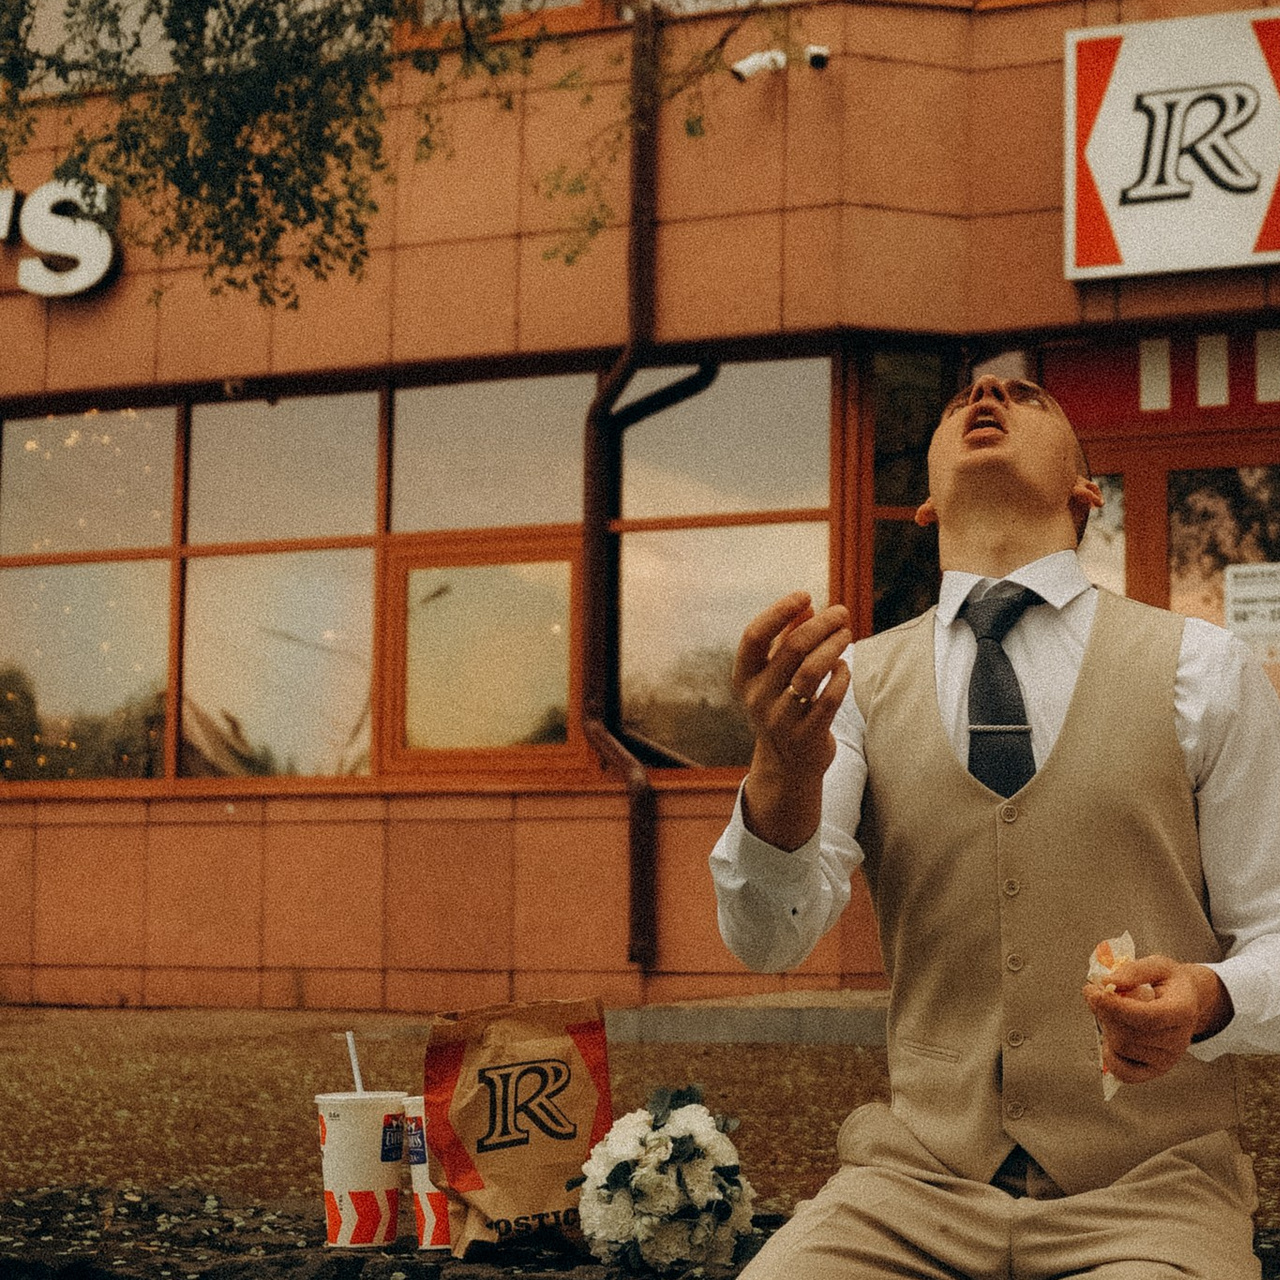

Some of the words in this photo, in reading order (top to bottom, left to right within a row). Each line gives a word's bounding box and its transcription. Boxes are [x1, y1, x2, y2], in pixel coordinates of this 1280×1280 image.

[1118, 80, 1261, 206] R
[476, 1057, 579, 1154] R
[485, 1207, 580, 1236] OSTIC
